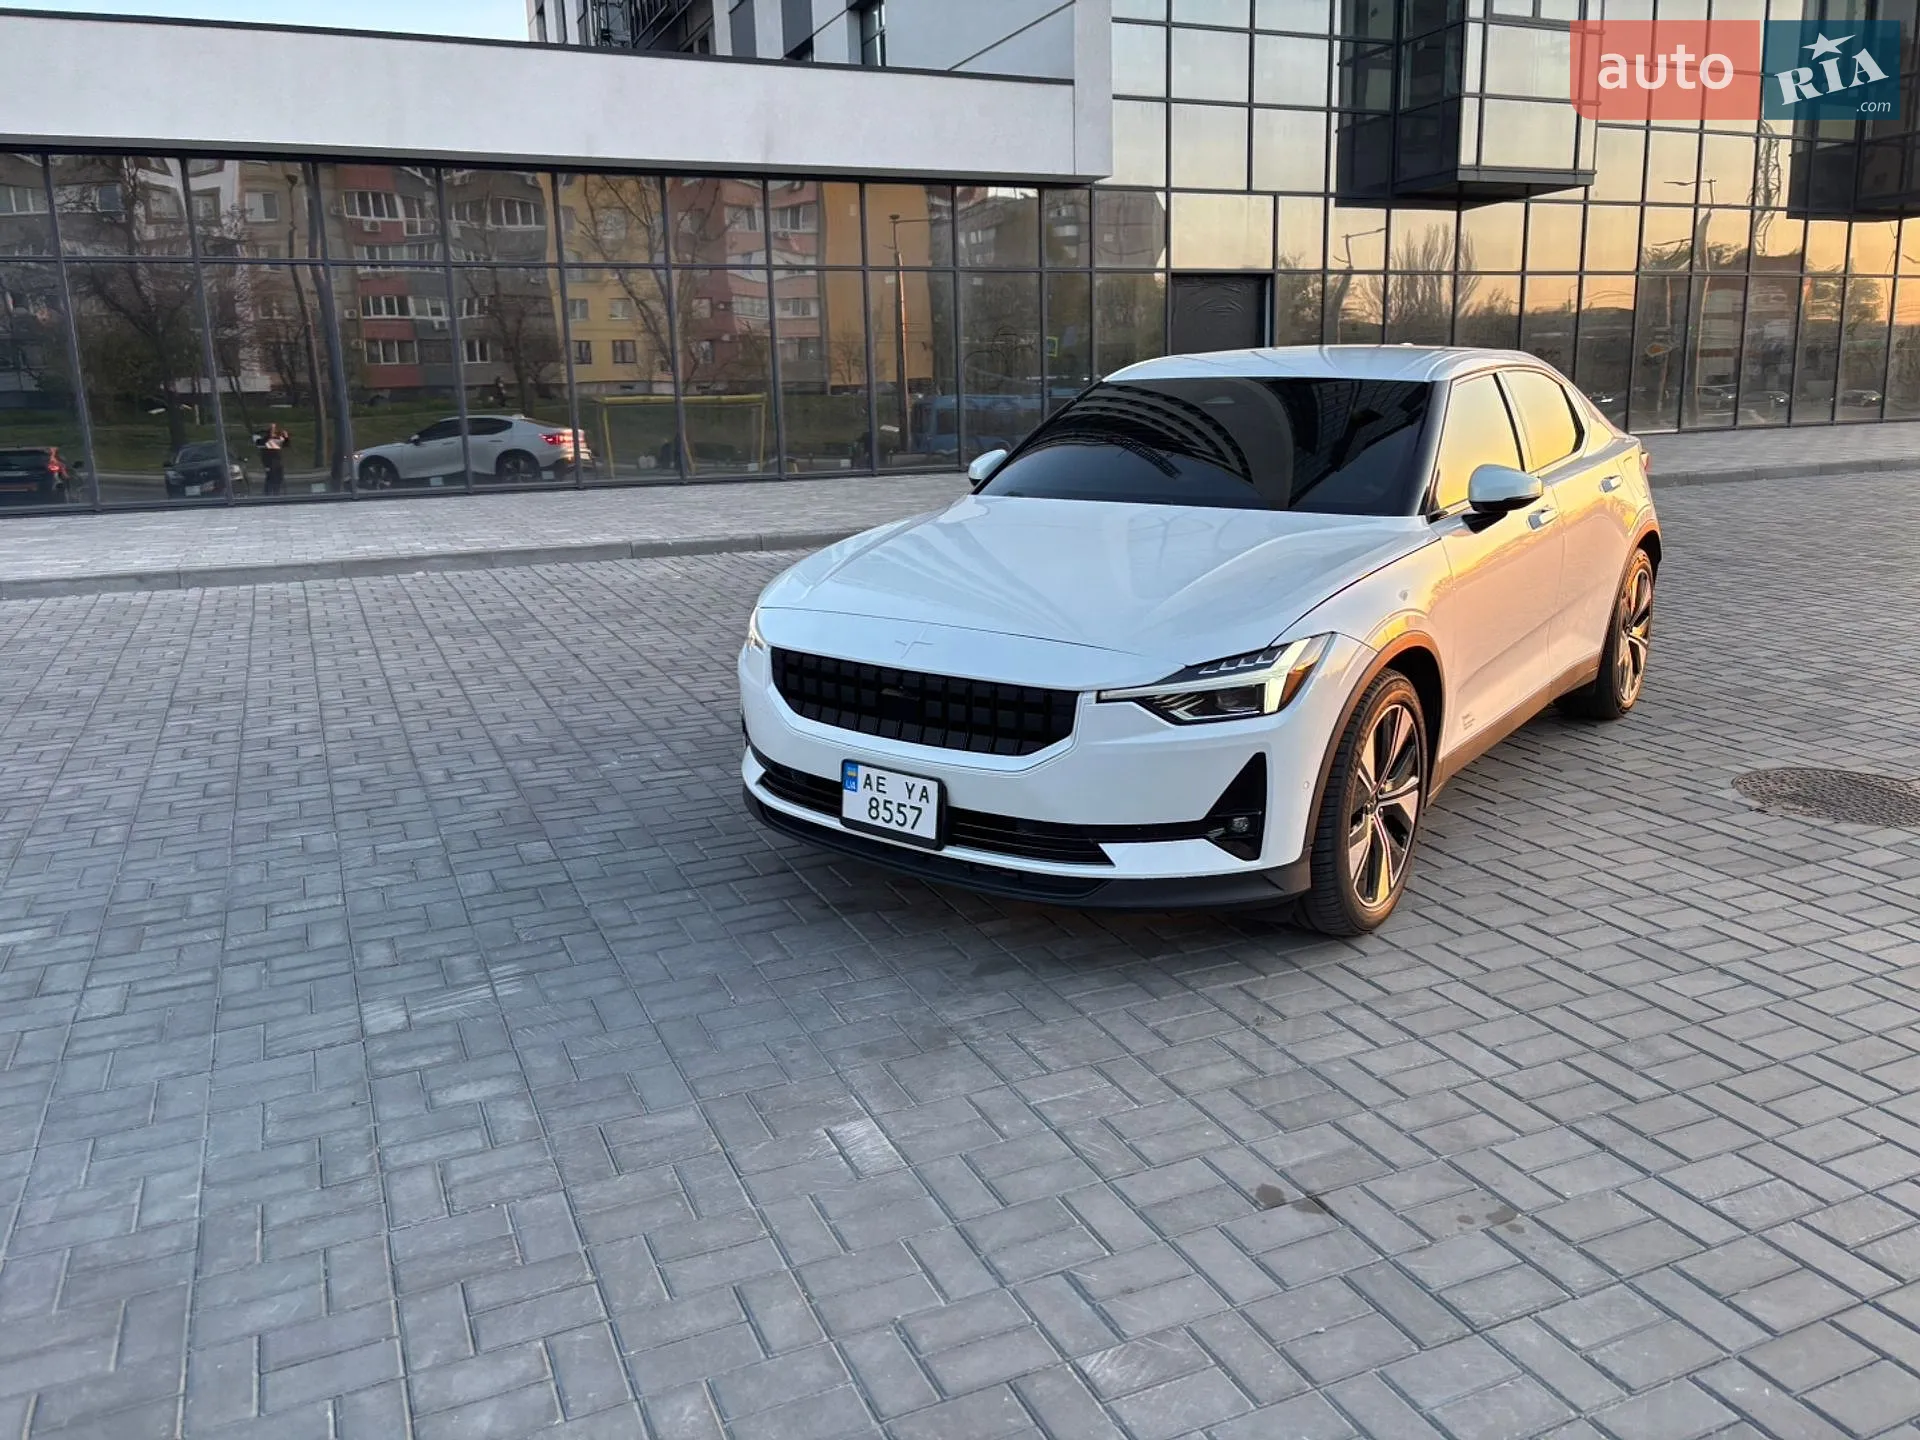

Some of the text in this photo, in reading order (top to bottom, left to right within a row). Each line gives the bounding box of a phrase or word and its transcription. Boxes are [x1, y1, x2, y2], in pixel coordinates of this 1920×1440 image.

[863, 773, 930, 804] AE YA
[868, 796, 923, 830] 8557
